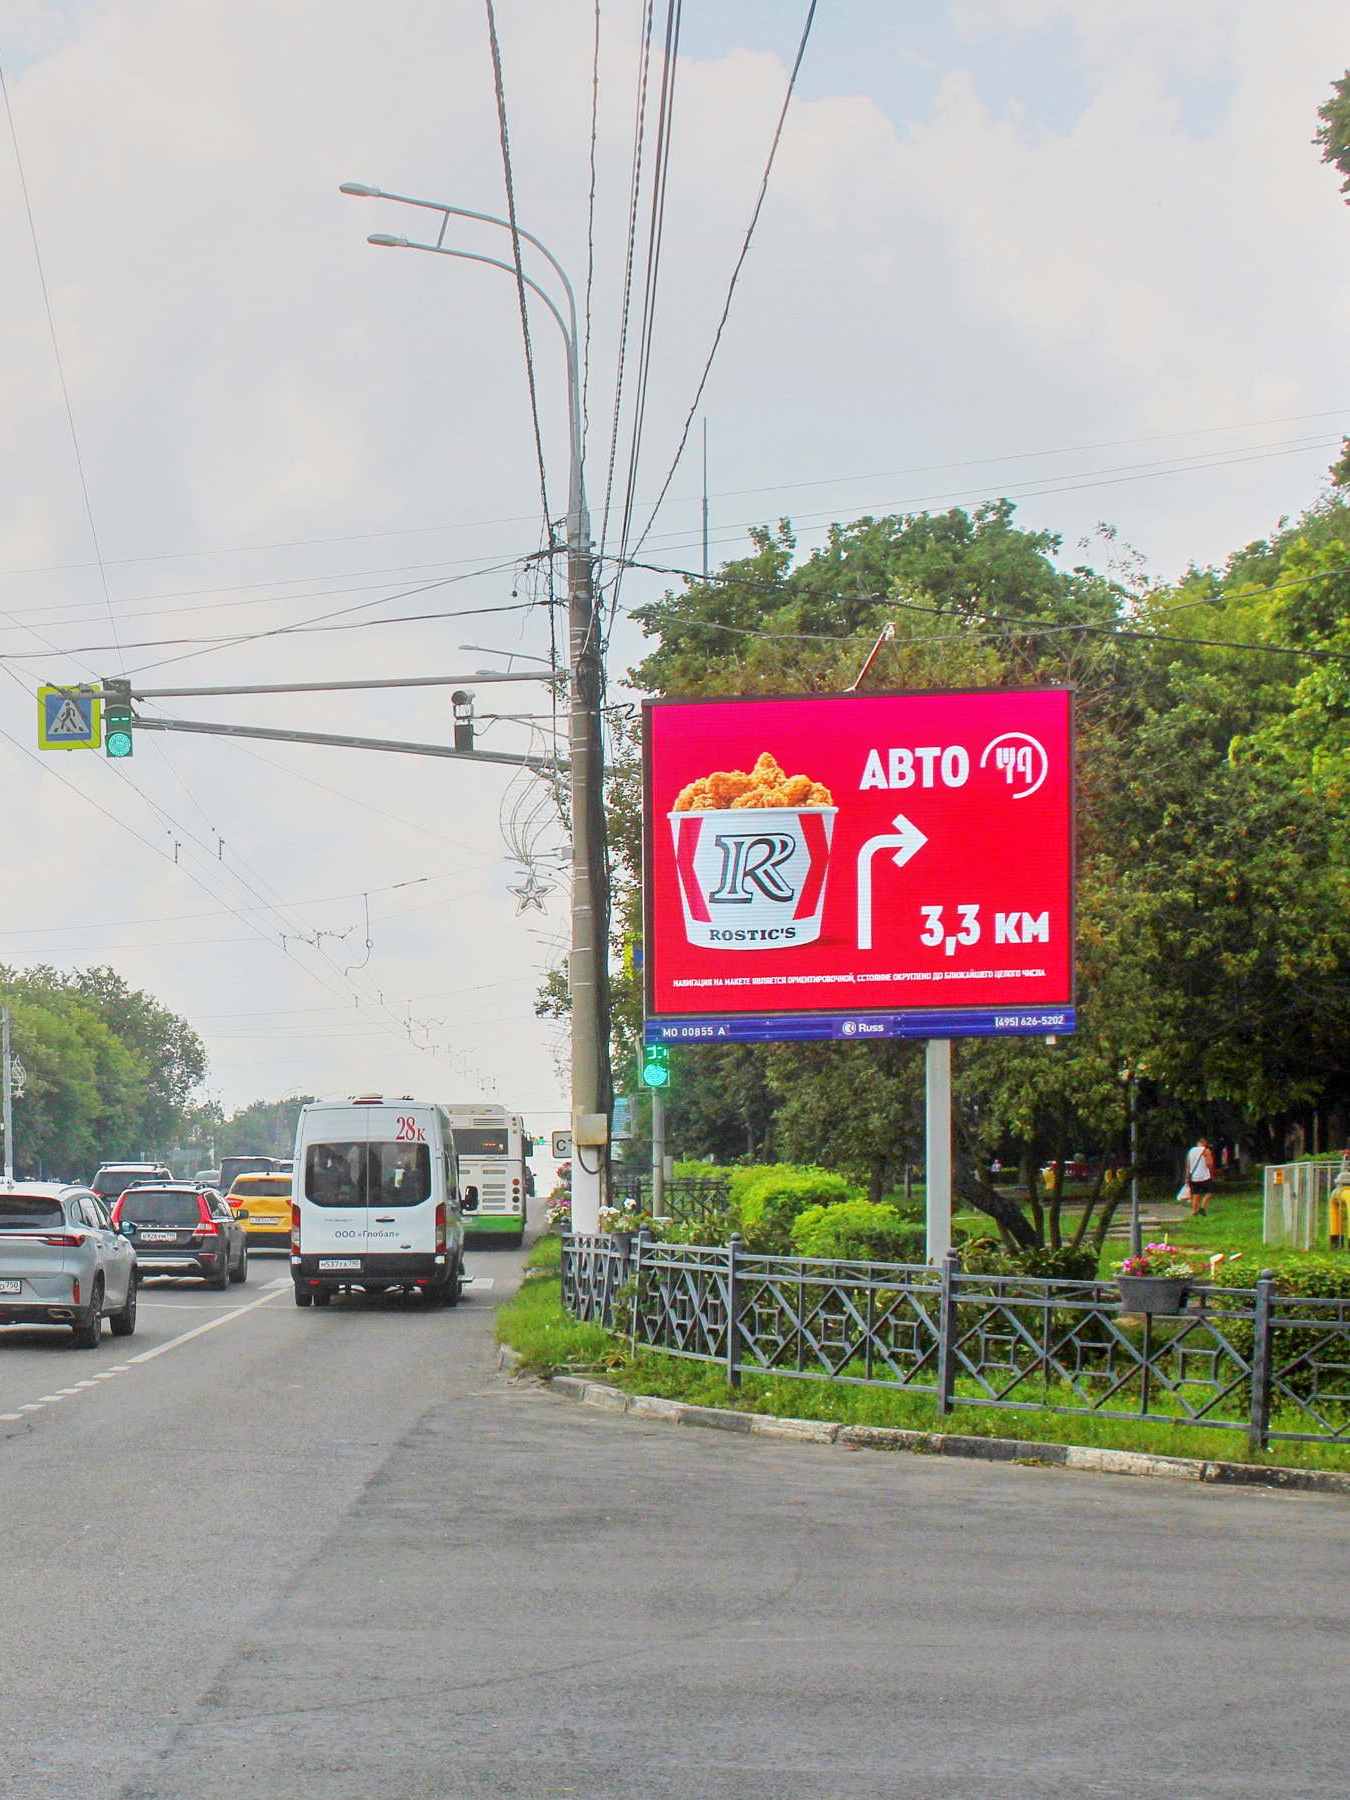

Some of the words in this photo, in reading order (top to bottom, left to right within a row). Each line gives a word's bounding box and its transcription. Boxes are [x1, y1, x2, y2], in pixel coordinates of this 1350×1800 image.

[859, 745, 970, 790] АВТО
[709, 927, 796, 941] ROSTIC'S
[920, 904, 981, 956] 3,3
[673, 978, 712, 988] НАВИГАЦИЯ
[714, 978, 724, 986] НА
[725, 977, 751, 986] МАКЕТЕ
[752, 976, 787, 985] ЯВЛЯЕТСЯ
[893, 972, 931, 982] ОКРУГЛЕНО
[933, 972, 943, 981] ДО
[944, 969, 994, 979] БЛИЖАЙШЕГО
[995, 970, 1020, 979] ЦЕЛОГО
[1022, 969, 1046, 978] ЧИСЛА
[1021, 1015, 1064, 1026] 626-5202
[681, 1027, 713, 1037] 00855
[858, 1023, 884, 1033] Russ
[335, 1230, 356, 1239] ООО
